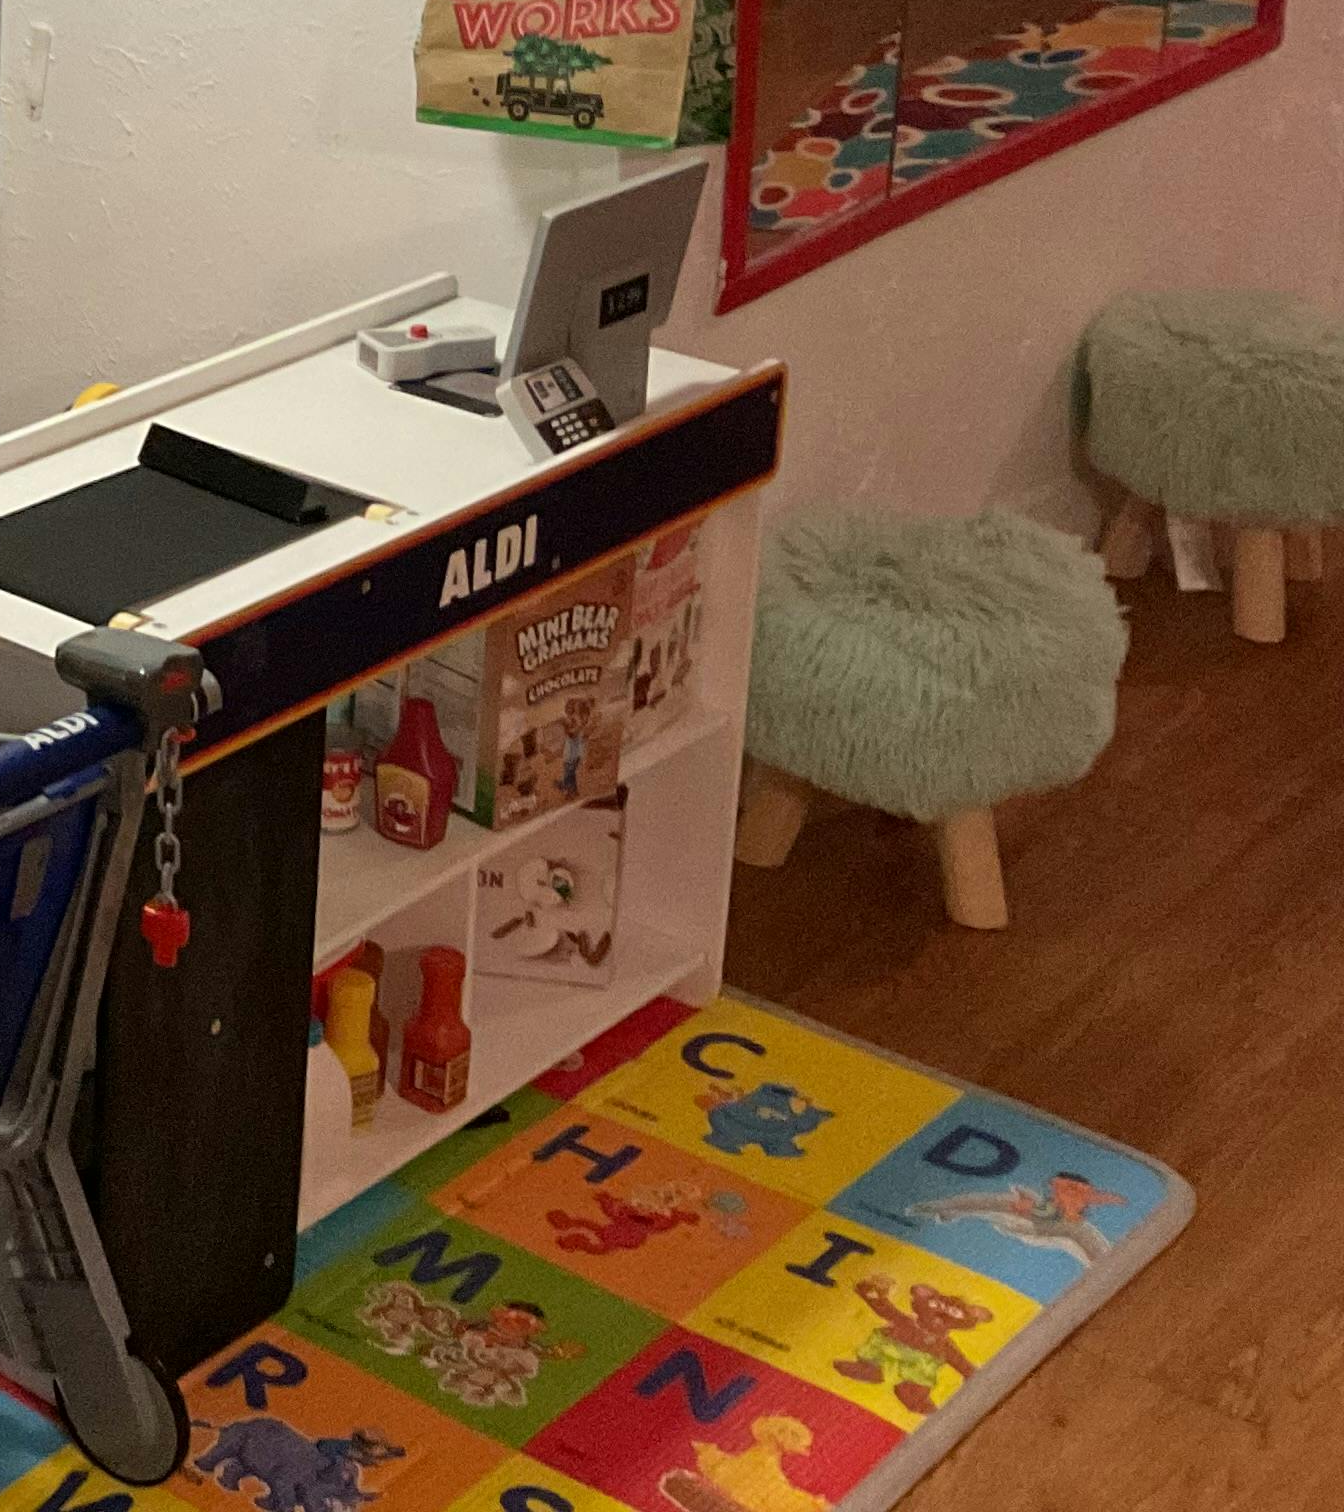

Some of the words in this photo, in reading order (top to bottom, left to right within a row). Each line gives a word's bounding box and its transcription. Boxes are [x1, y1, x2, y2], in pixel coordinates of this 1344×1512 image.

[438, 515, 539, 609] ALDI
[517, 609, 570, 657] MINI
[572, 604, 620, 633] BEAR
[523, 629, 610, 672] GRAHAMS
[528, 667, 601, 702] CHOCOLATE
[24, 711, 100, 751] ALDI
[681, 1032, 767, 1080] C
[531, 1124, 644, 1184] H
[922, 1124, 1021, 1177] D
[372, 1231, 504, 1304] M
[784, 1230, 875, 1287] I
[206, 1341, 308, 1410] R
[633, 1347, 758, 1424] N
